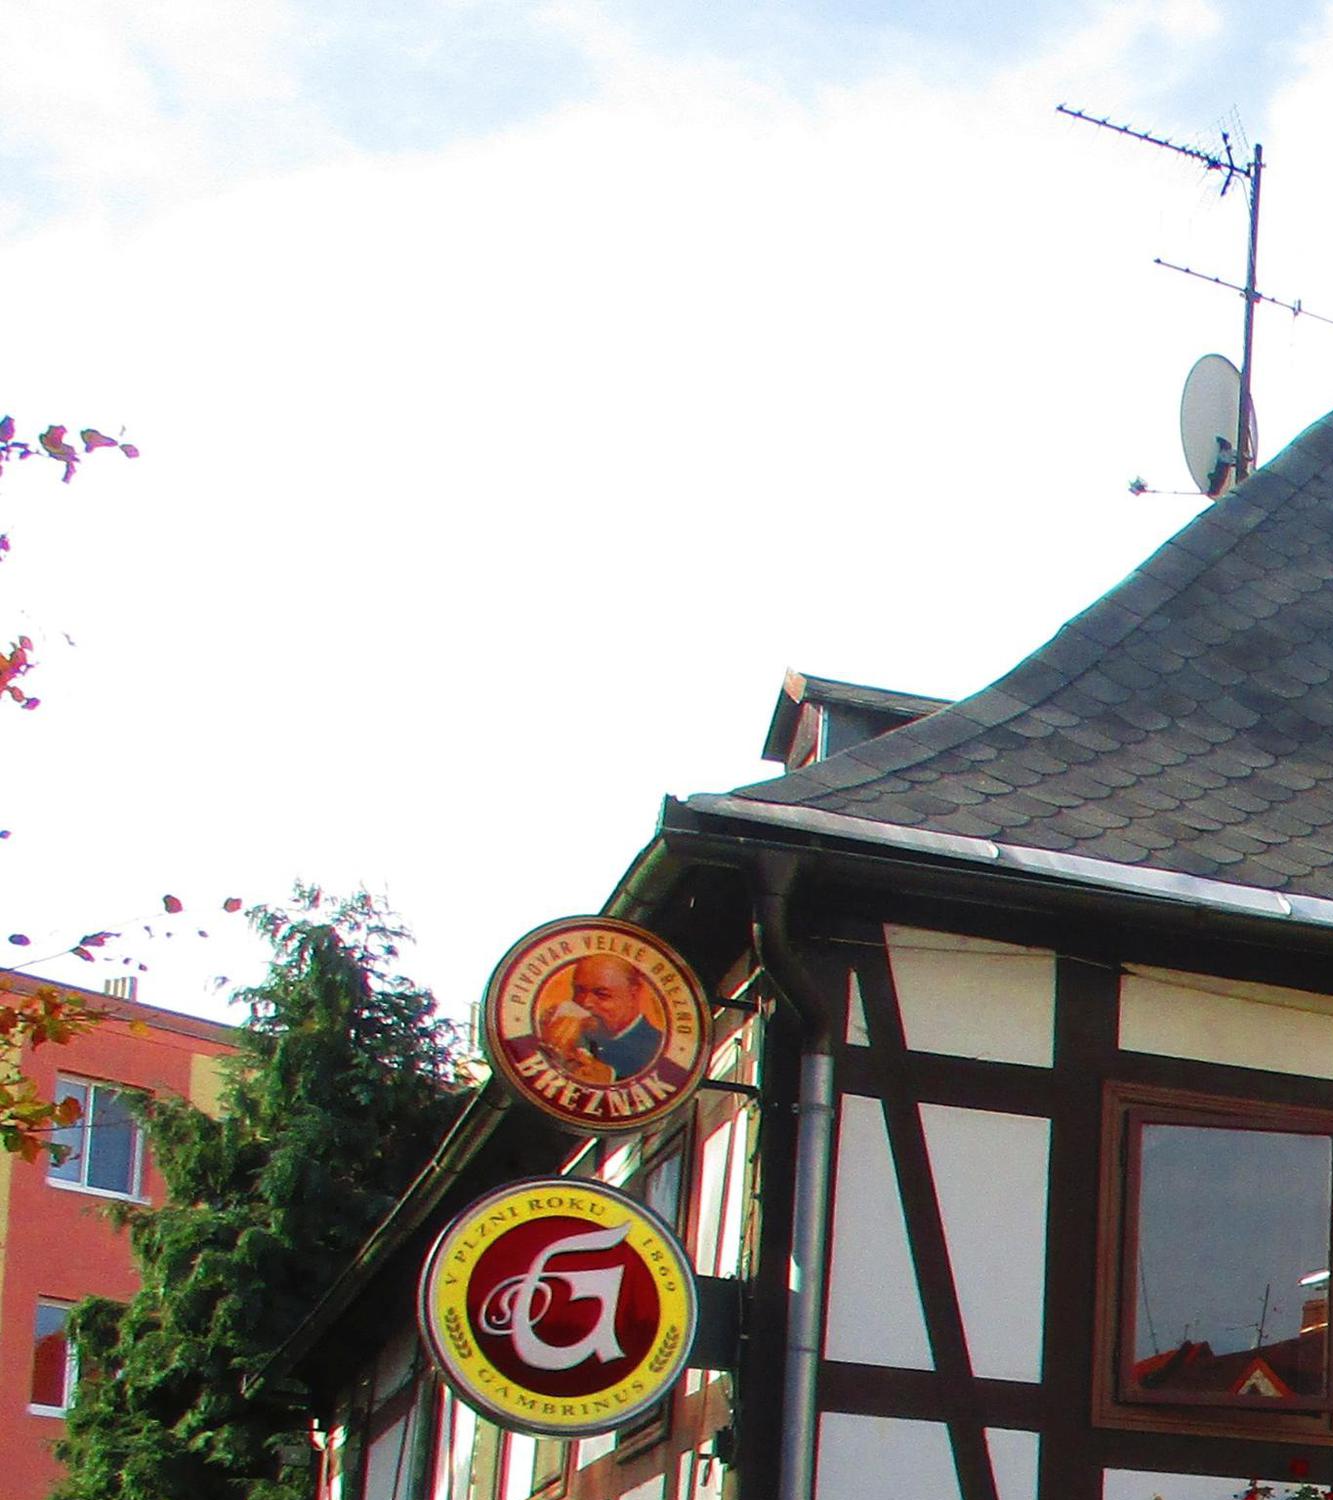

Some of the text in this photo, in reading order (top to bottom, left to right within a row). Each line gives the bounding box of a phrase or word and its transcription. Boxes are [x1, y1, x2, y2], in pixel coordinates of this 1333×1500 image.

[511, 941, 572, 1005] PIVOVAR
[446, 1273, 458, 1286] V
[528, 1196, 606, 1217] ROKU
[641, 1237, 677, 1292] 1869
[478, 1368, 645, 1416] GAMBRINUS
